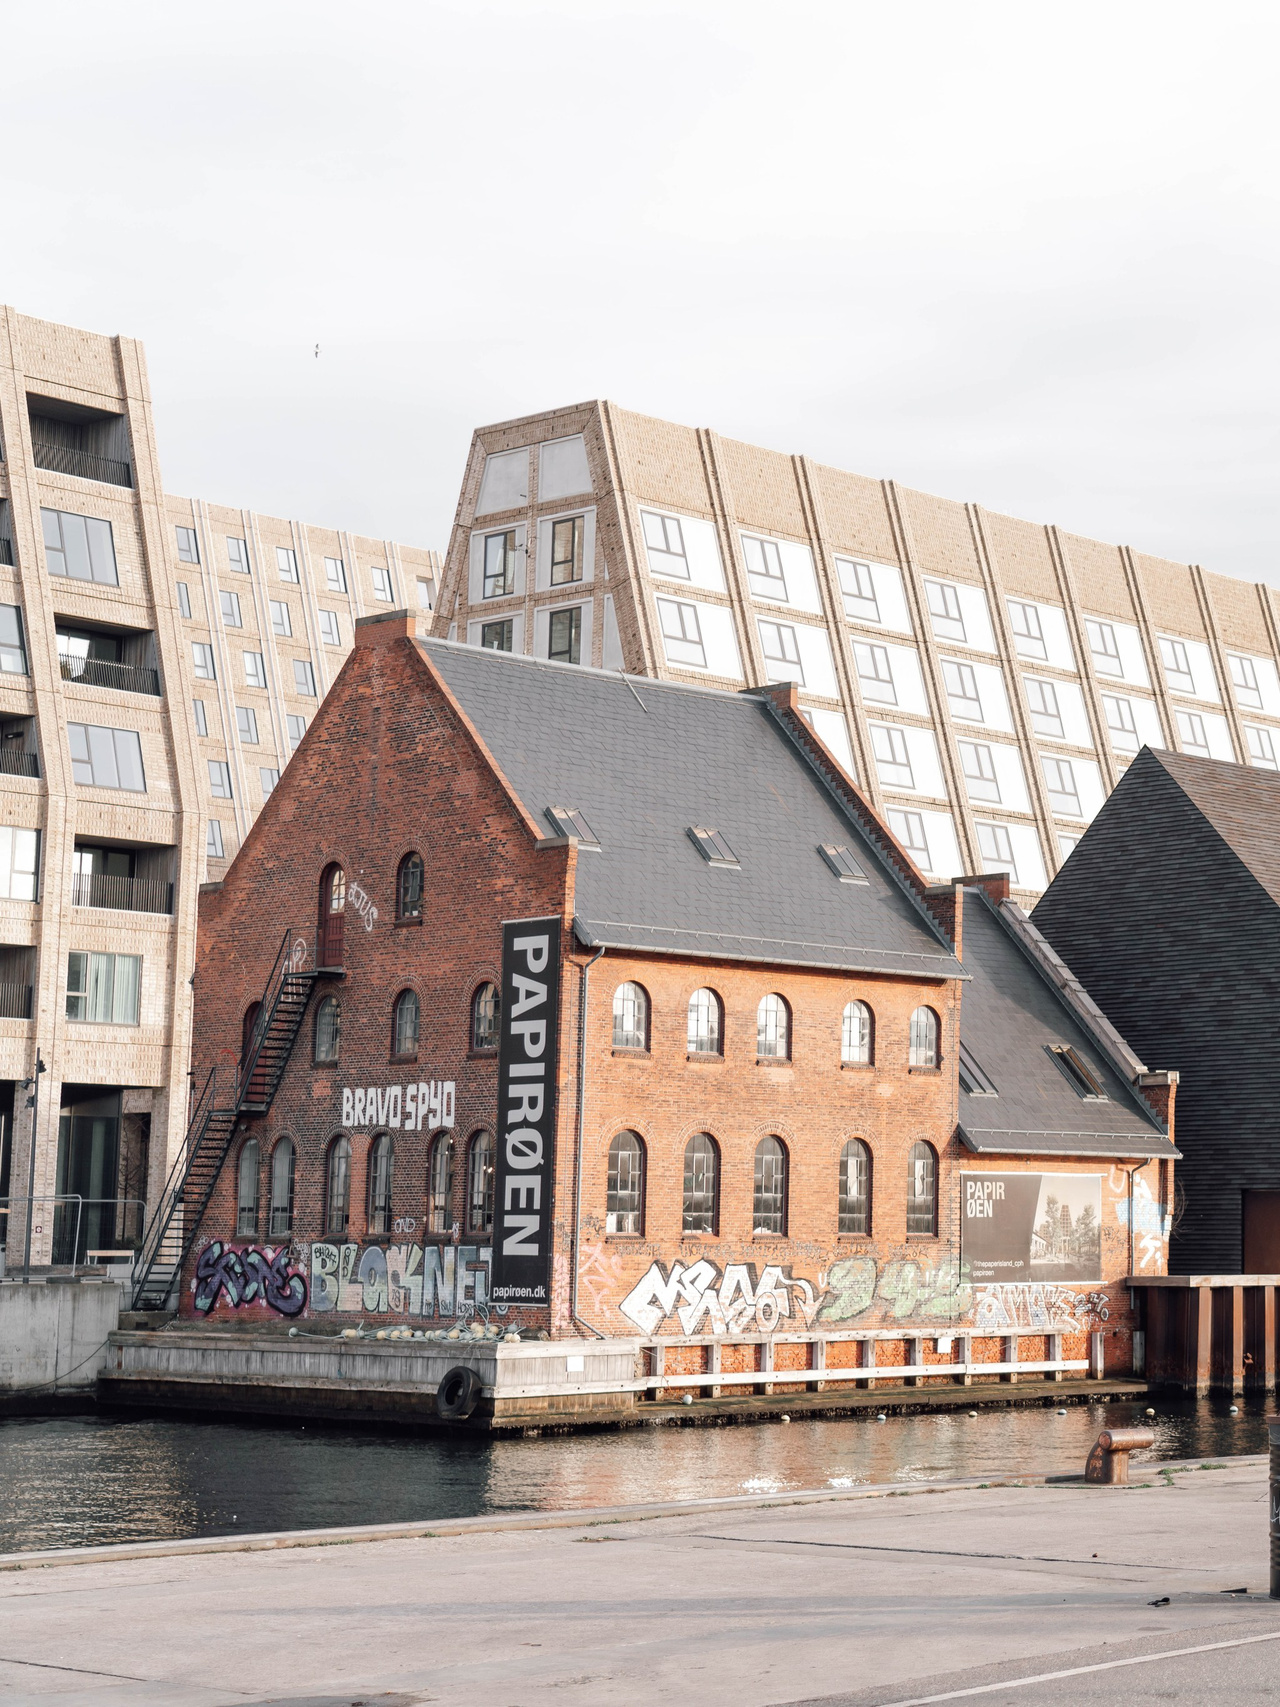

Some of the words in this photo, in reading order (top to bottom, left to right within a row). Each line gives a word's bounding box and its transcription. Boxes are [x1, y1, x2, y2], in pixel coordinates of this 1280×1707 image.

[502, 934, 549, 1256] PAPIRØEN
[342, 1086, 402, 1127] BRAVO
[966, 1181, 1006, 1200] PAPIR
[966, 1199, 993, 1218] ØEN
[493, 1285, 546, 1299] papirøen.dk
